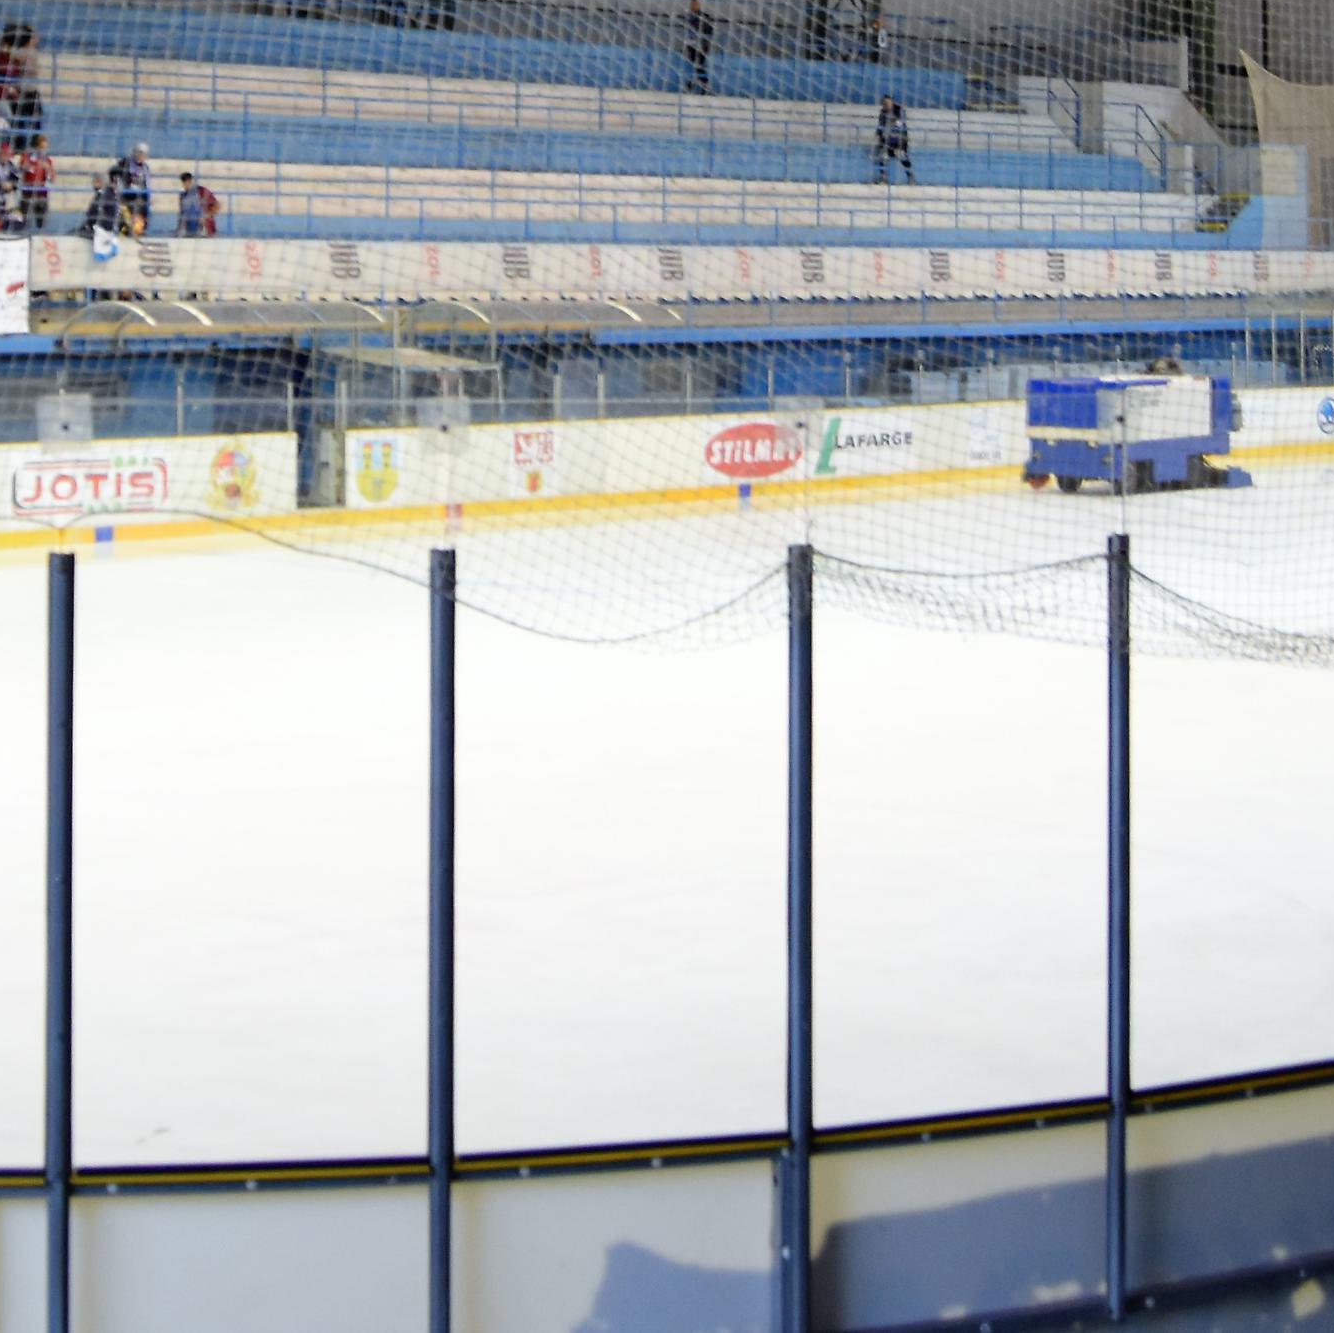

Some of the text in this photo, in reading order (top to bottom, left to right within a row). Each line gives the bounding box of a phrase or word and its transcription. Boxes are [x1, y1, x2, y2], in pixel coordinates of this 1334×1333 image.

[136, 238, 174, 279] JUB
[328, 242, 362, 280] JUB
[656, 247, 685, 282] JUB
[834, 431, 913, 449] LAFARGE
[23, 471, 155, 503] JOTIS
